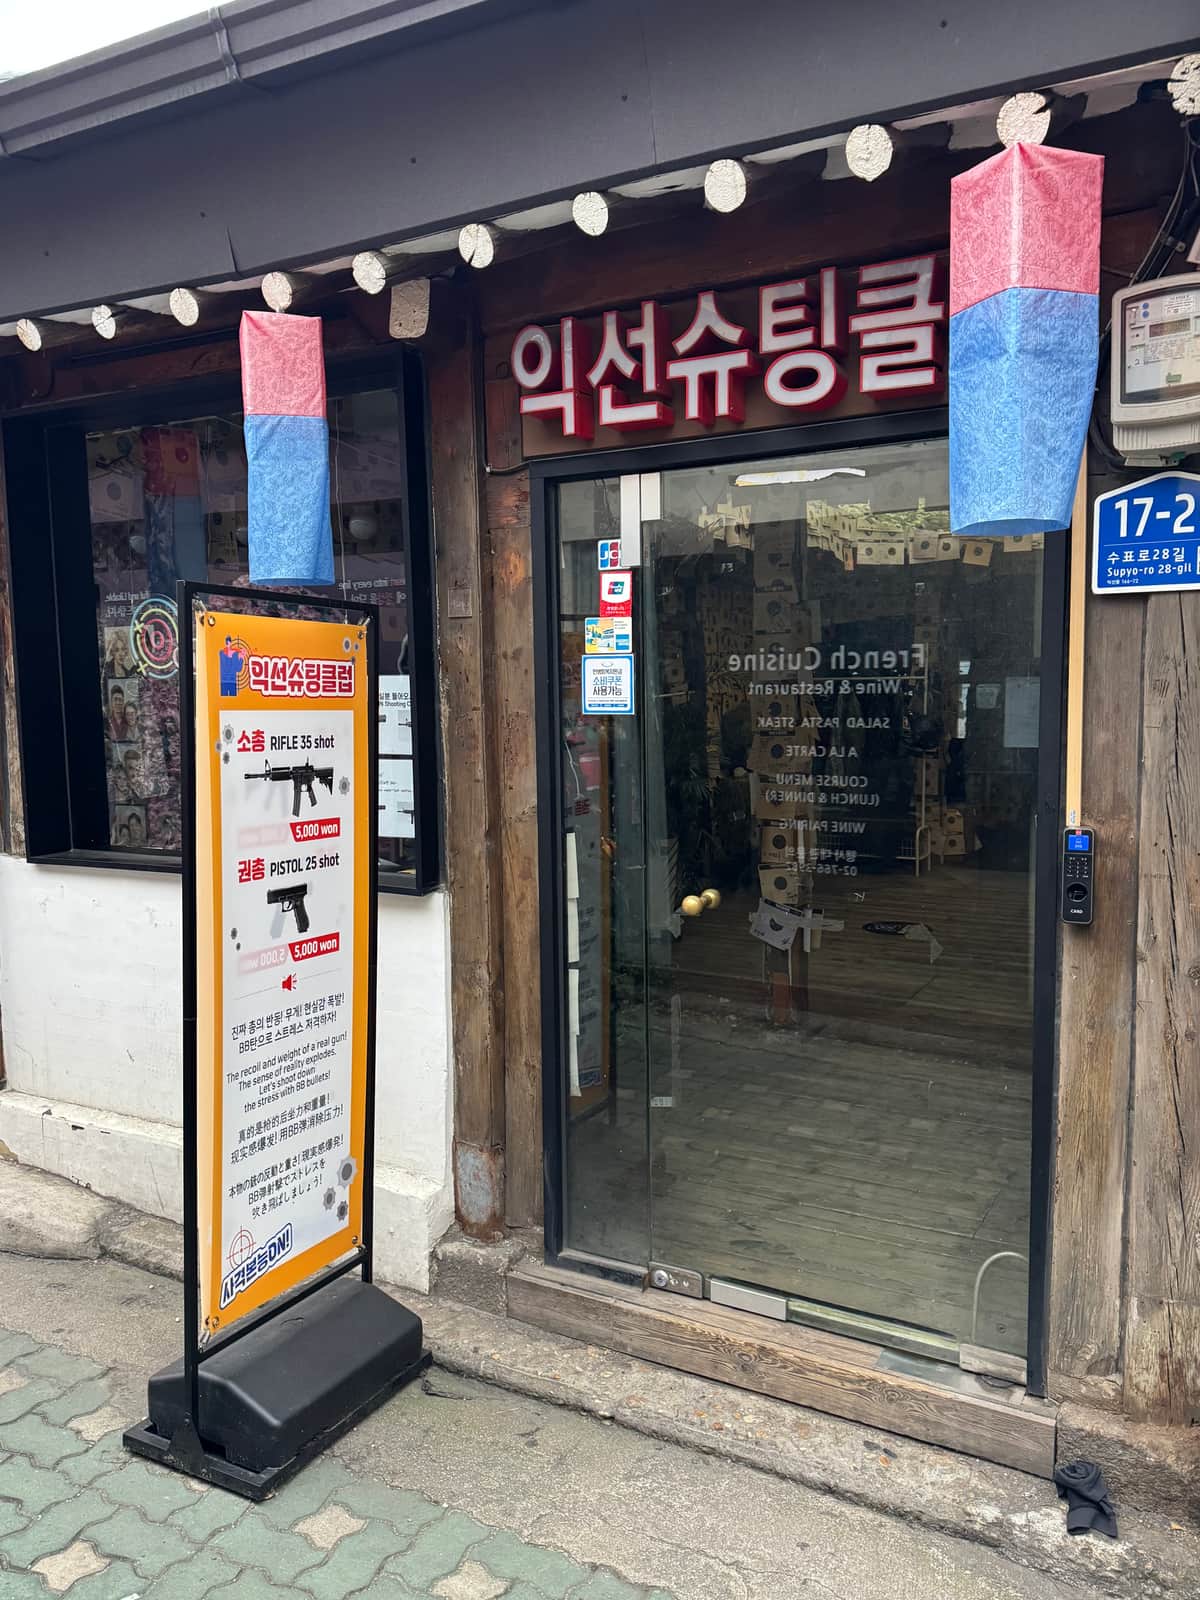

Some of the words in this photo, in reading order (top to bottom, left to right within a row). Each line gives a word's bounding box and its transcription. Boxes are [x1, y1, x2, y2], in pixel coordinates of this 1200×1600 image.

[1115, 494, 1195, 537] 17-2
[1107, 547, 1185, 564] 수표로28길
[1107, 566, 1154, 578] Supyo-ro
[1158, 563, 1192, 575] 28-gil
[250, 660, 353, 693] 익선슈팅클럽
[592, 686, 622, 696] 사용가능
[237, 729, 265, 753] 소총
[270, 735, 298, 751] RIFLE
[300, 735, 312, 750] 35
[314, 734, 335, 749] shot
[295, 823, 319, 839] 5,000
[321, 822, 338, 836] won
[238, 857, 265, 883] 권총
[270, 857, 303, 877] PISTOL
[306, 855, 317, 871] 25
[319, 852, 340, 868] shot
[294, 940, 318, 958] 5,000
[320, 937, 337, 952] won
[231, 1022, 246, 1040] 진짜
[248, 1016, 264, 1035] 총의
[266, 1010, 283, 1029] 반동!
[285, 1004, 302, 1021] 무게!
[304, 997, 325, 1016] 현실감
[328, 992, 345, 1007] 폭발!
[239, 1031, 273, 1054] BB탄으로
[275, 1021, 304, 1041] 스트레스
[305, 1010, 336, 1030] 저격하자!
[226, 1071, 239, 1084] The
[240, 1061, 261, 1078] recoil
[262, 1056, 276, 1070] and
[277, 1047, 301, 1066] weight
[302, 1042, 310, 1052] of
[316, 1036, 330, 1049] real
[331, 1031, 347, 1047] gun!
[239, 1080, 251, 1091] The
[252, 1073, 274, 1086] sense
[275, 1068, 282, 1077] of
[283, 1060, 304, 1074] reality
[305, 1048, 337, 1066] explodes.
[244, 1101, 256, 1113] the
[257, 1094, 279, 1107] stress
[280, 1084, 295, 1098] with
[296, 1079, 305, 1091] BB
[306, 1070, 331, 1088] bullets!
[259, 1082, 276, 1095] Let's
[277, 1073, 296, 1087] shoot
[297, 1066, 316, 1079] down
